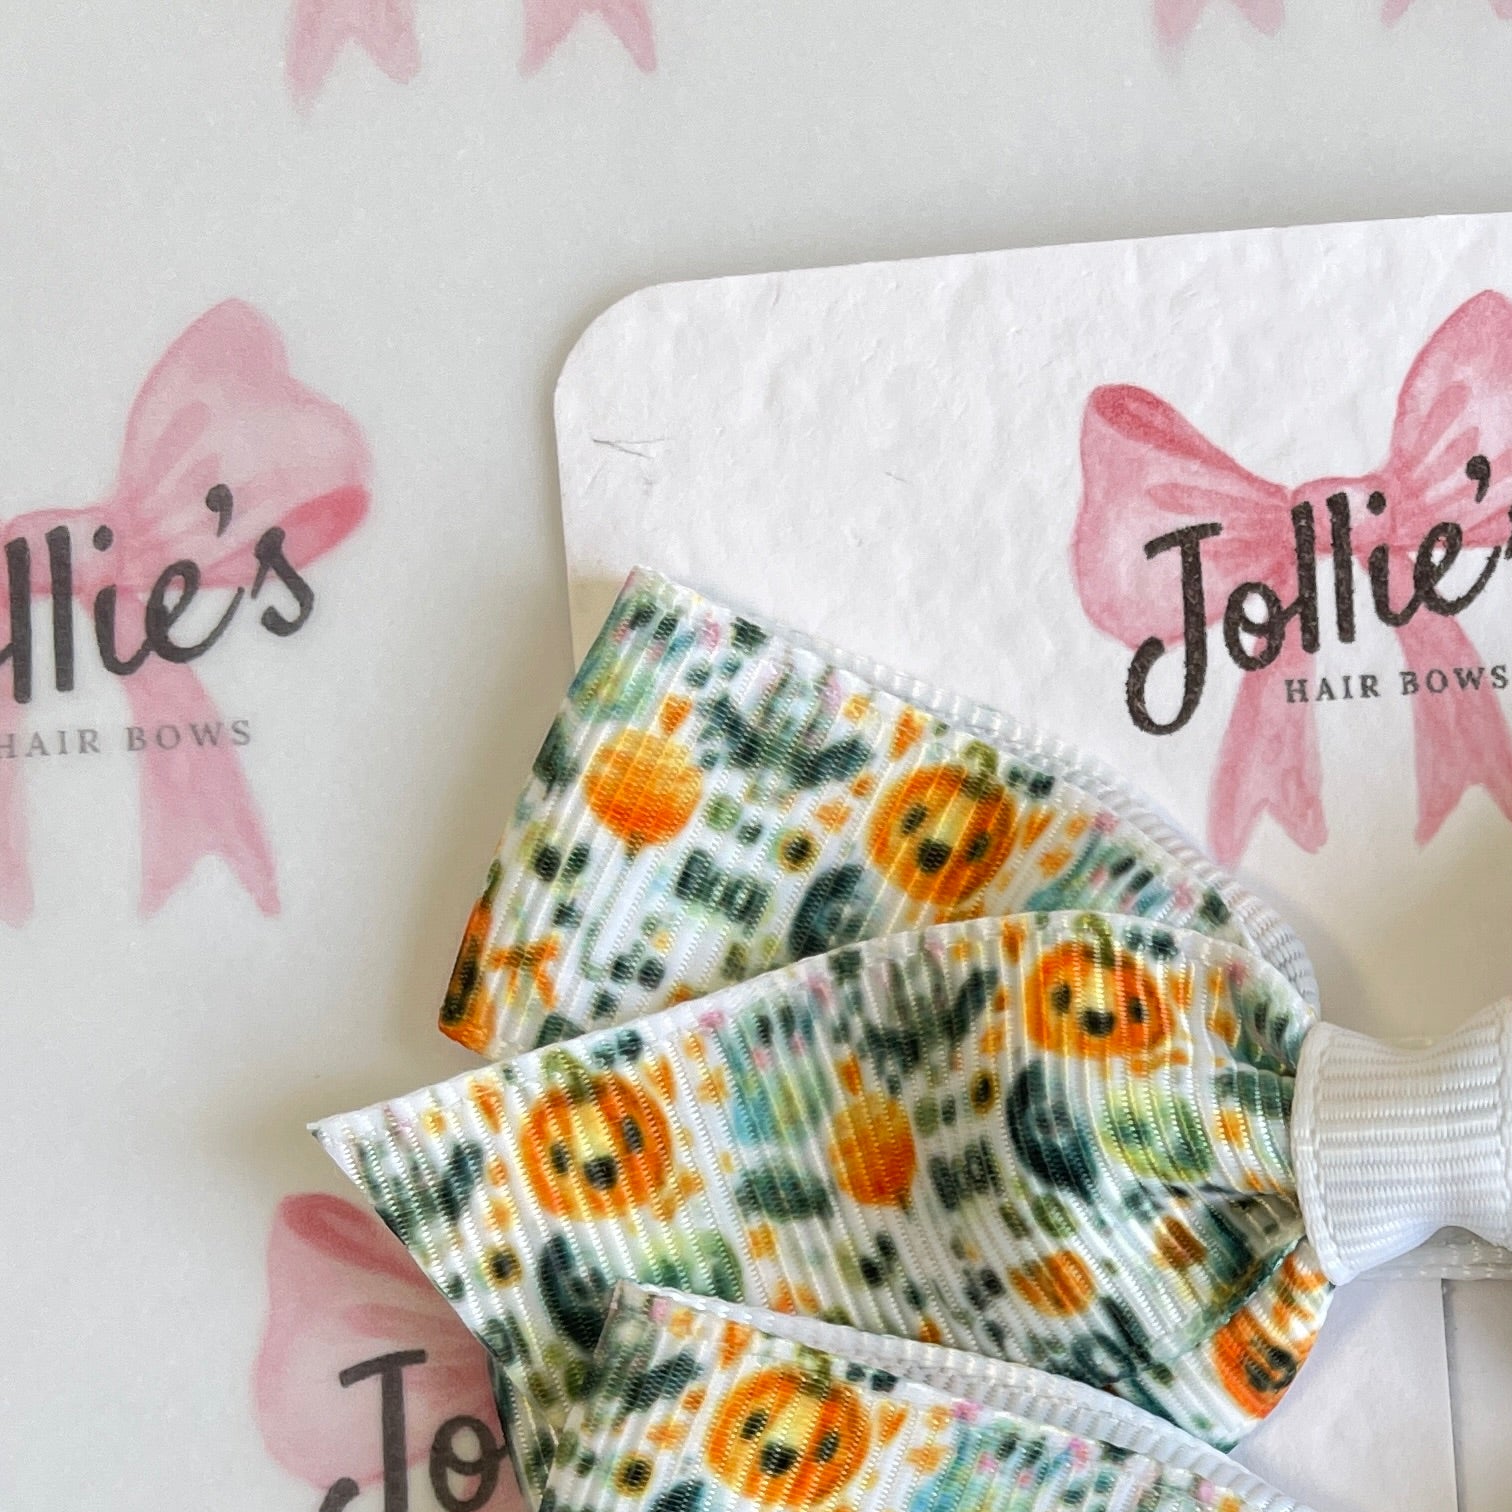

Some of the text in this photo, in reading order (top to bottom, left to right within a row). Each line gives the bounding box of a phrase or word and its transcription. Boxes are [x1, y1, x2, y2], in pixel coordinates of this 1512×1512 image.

[0, 484, 315, 704] llie's
[1284, 664, 1511, 703] HAIR BOWS
[126, 719, 251, 751] BOWS
